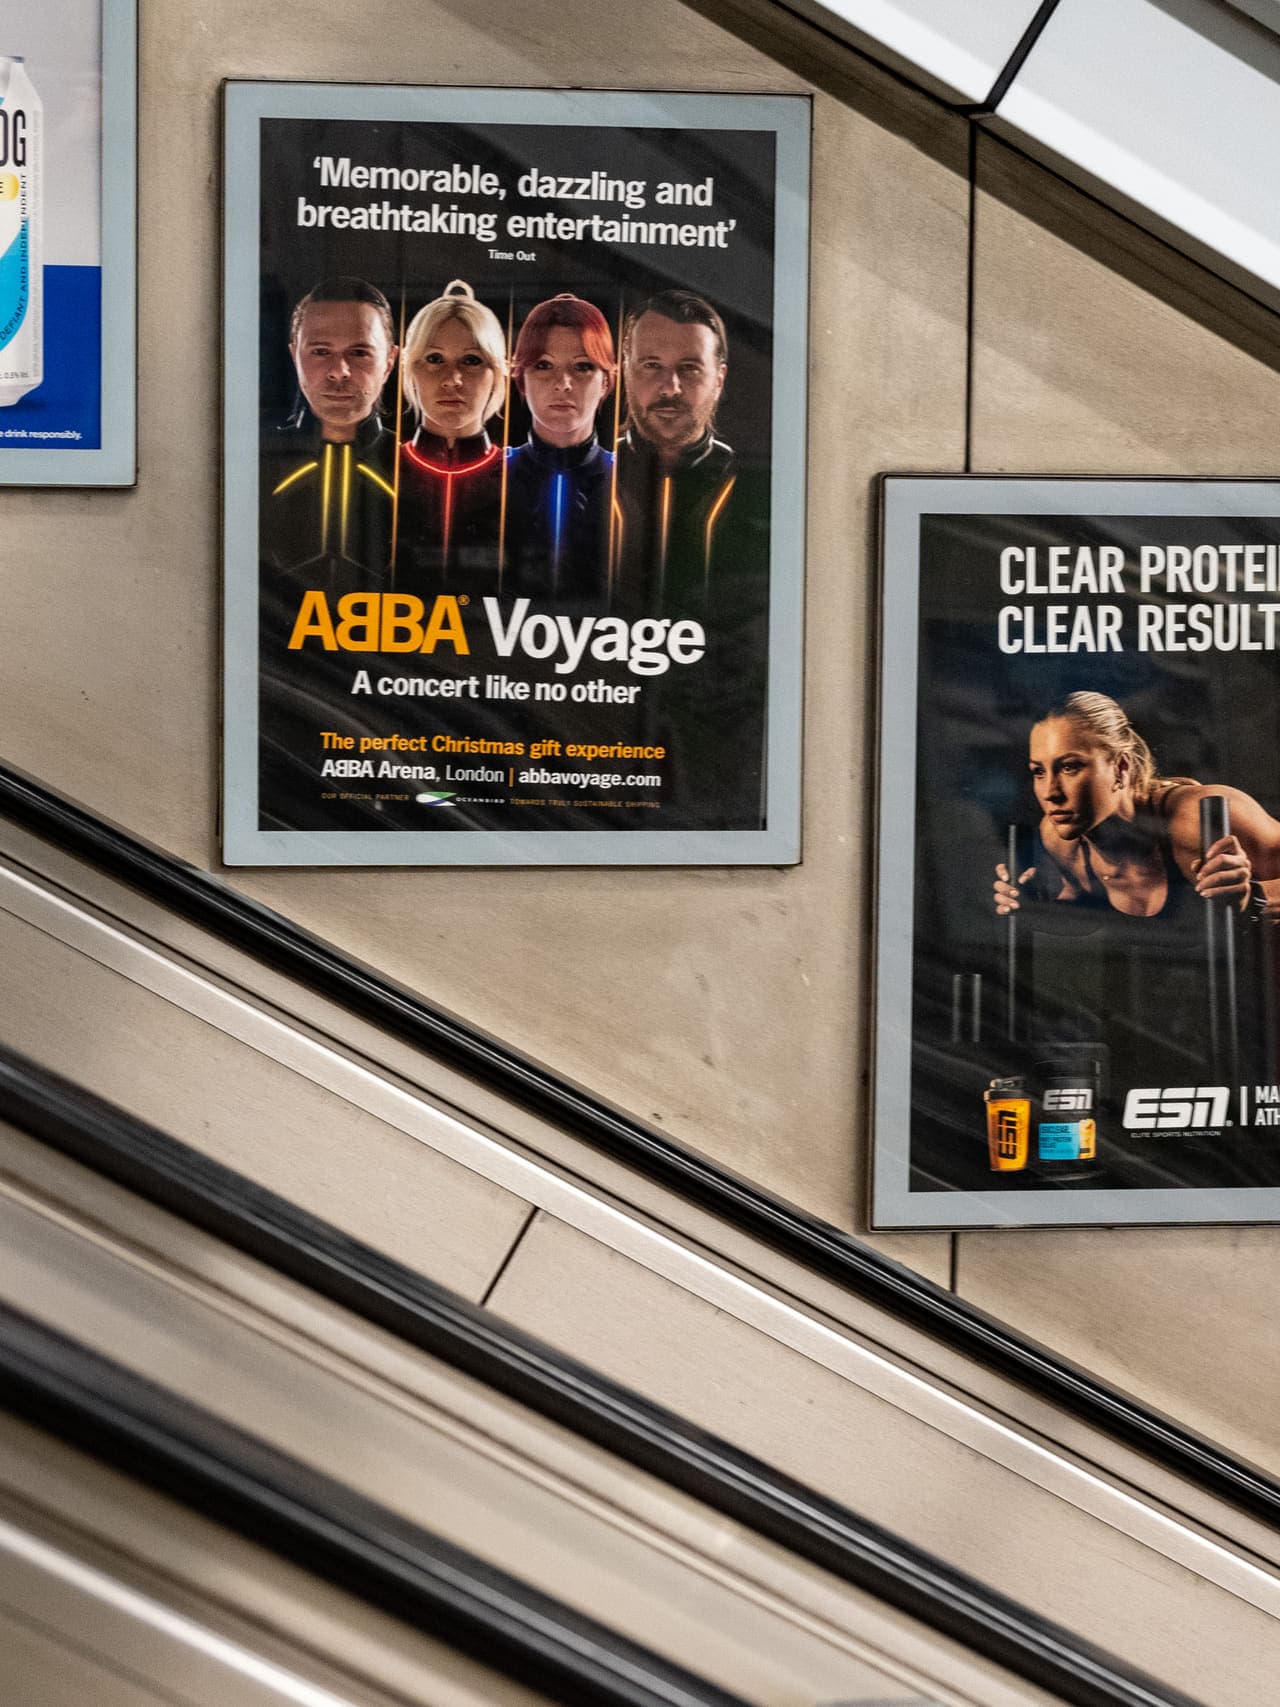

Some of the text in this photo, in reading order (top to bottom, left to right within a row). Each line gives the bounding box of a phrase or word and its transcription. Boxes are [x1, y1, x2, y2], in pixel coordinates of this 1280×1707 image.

[518, 168, 646, 208] dazzling
[655, 178, 714, 207] and
[297, 198, 497, 242] breathtaking
[488, 249, 536, 262] Time Out
[1000, 546, 1126, 595] CLEAR
[483, 597, 706, 676] Voyage
[998, 605, 1124, 654] CLEAR
[351, 670, 642, 705] A concert like no other
[320, 732, 666, 763] The perfect Christmas gift experience
[320, 759, 662, 789] ABBA Arena, London abbavoyage.com
